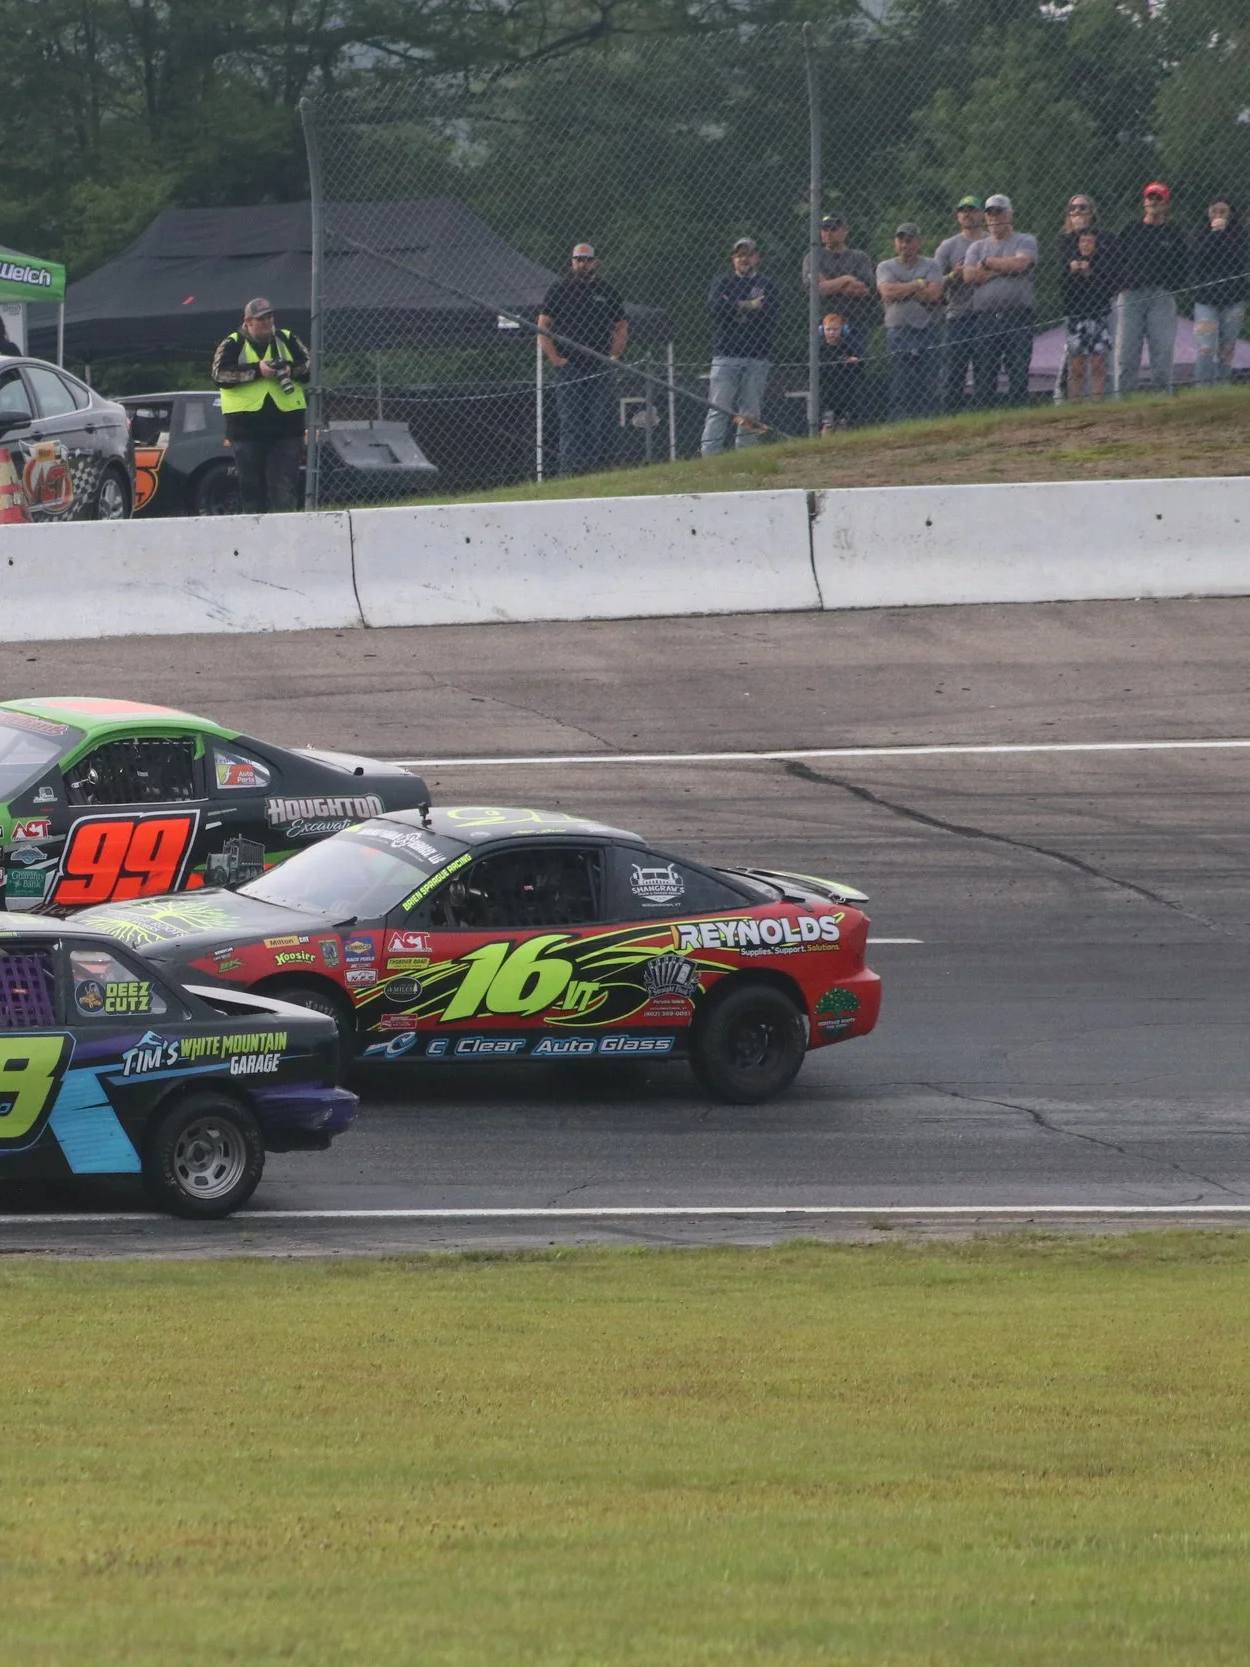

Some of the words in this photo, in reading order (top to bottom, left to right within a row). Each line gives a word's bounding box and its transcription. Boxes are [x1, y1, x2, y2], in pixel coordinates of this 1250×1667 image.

[54, 818, 192, 906] 99
[11, 870, 46, 881] Guaranty
[402, 891, 424, 911] BRIEN
[420, 869, 450, 896] SPRAGUE
[447, 852, 472, 878] RACING
[22, 880, 41, 889] Bank
[677, 915, 841, 950] REYNOLDS
[269, 938, 295, 947] Milton
[740, 947, 774, 957] Supplies.
[774, 944, 807, 955] Support.
[807, 943, 841, 952] Solutions.
[274, 950, 316, 966] Hoosier
[440, 934, 574, 1023] 16
[562, 980, 601, 1012] VT
[106, 981, 150, 997] DEEZ
[105, 996, 150, 1012] CUTZ
[456, 1038, 524, 1053] Clear
[532, 1038, 597, 1053] Auto
[599, 1036, 672, 1052] Glass
[122, 1038, 180, 1077] TIM'S
[180, 1036, 221, 1060] WHITE
[222, 1031, 288, 1059] MOUNTAIN
[230, 1052, 281, 1076] GARAGE
